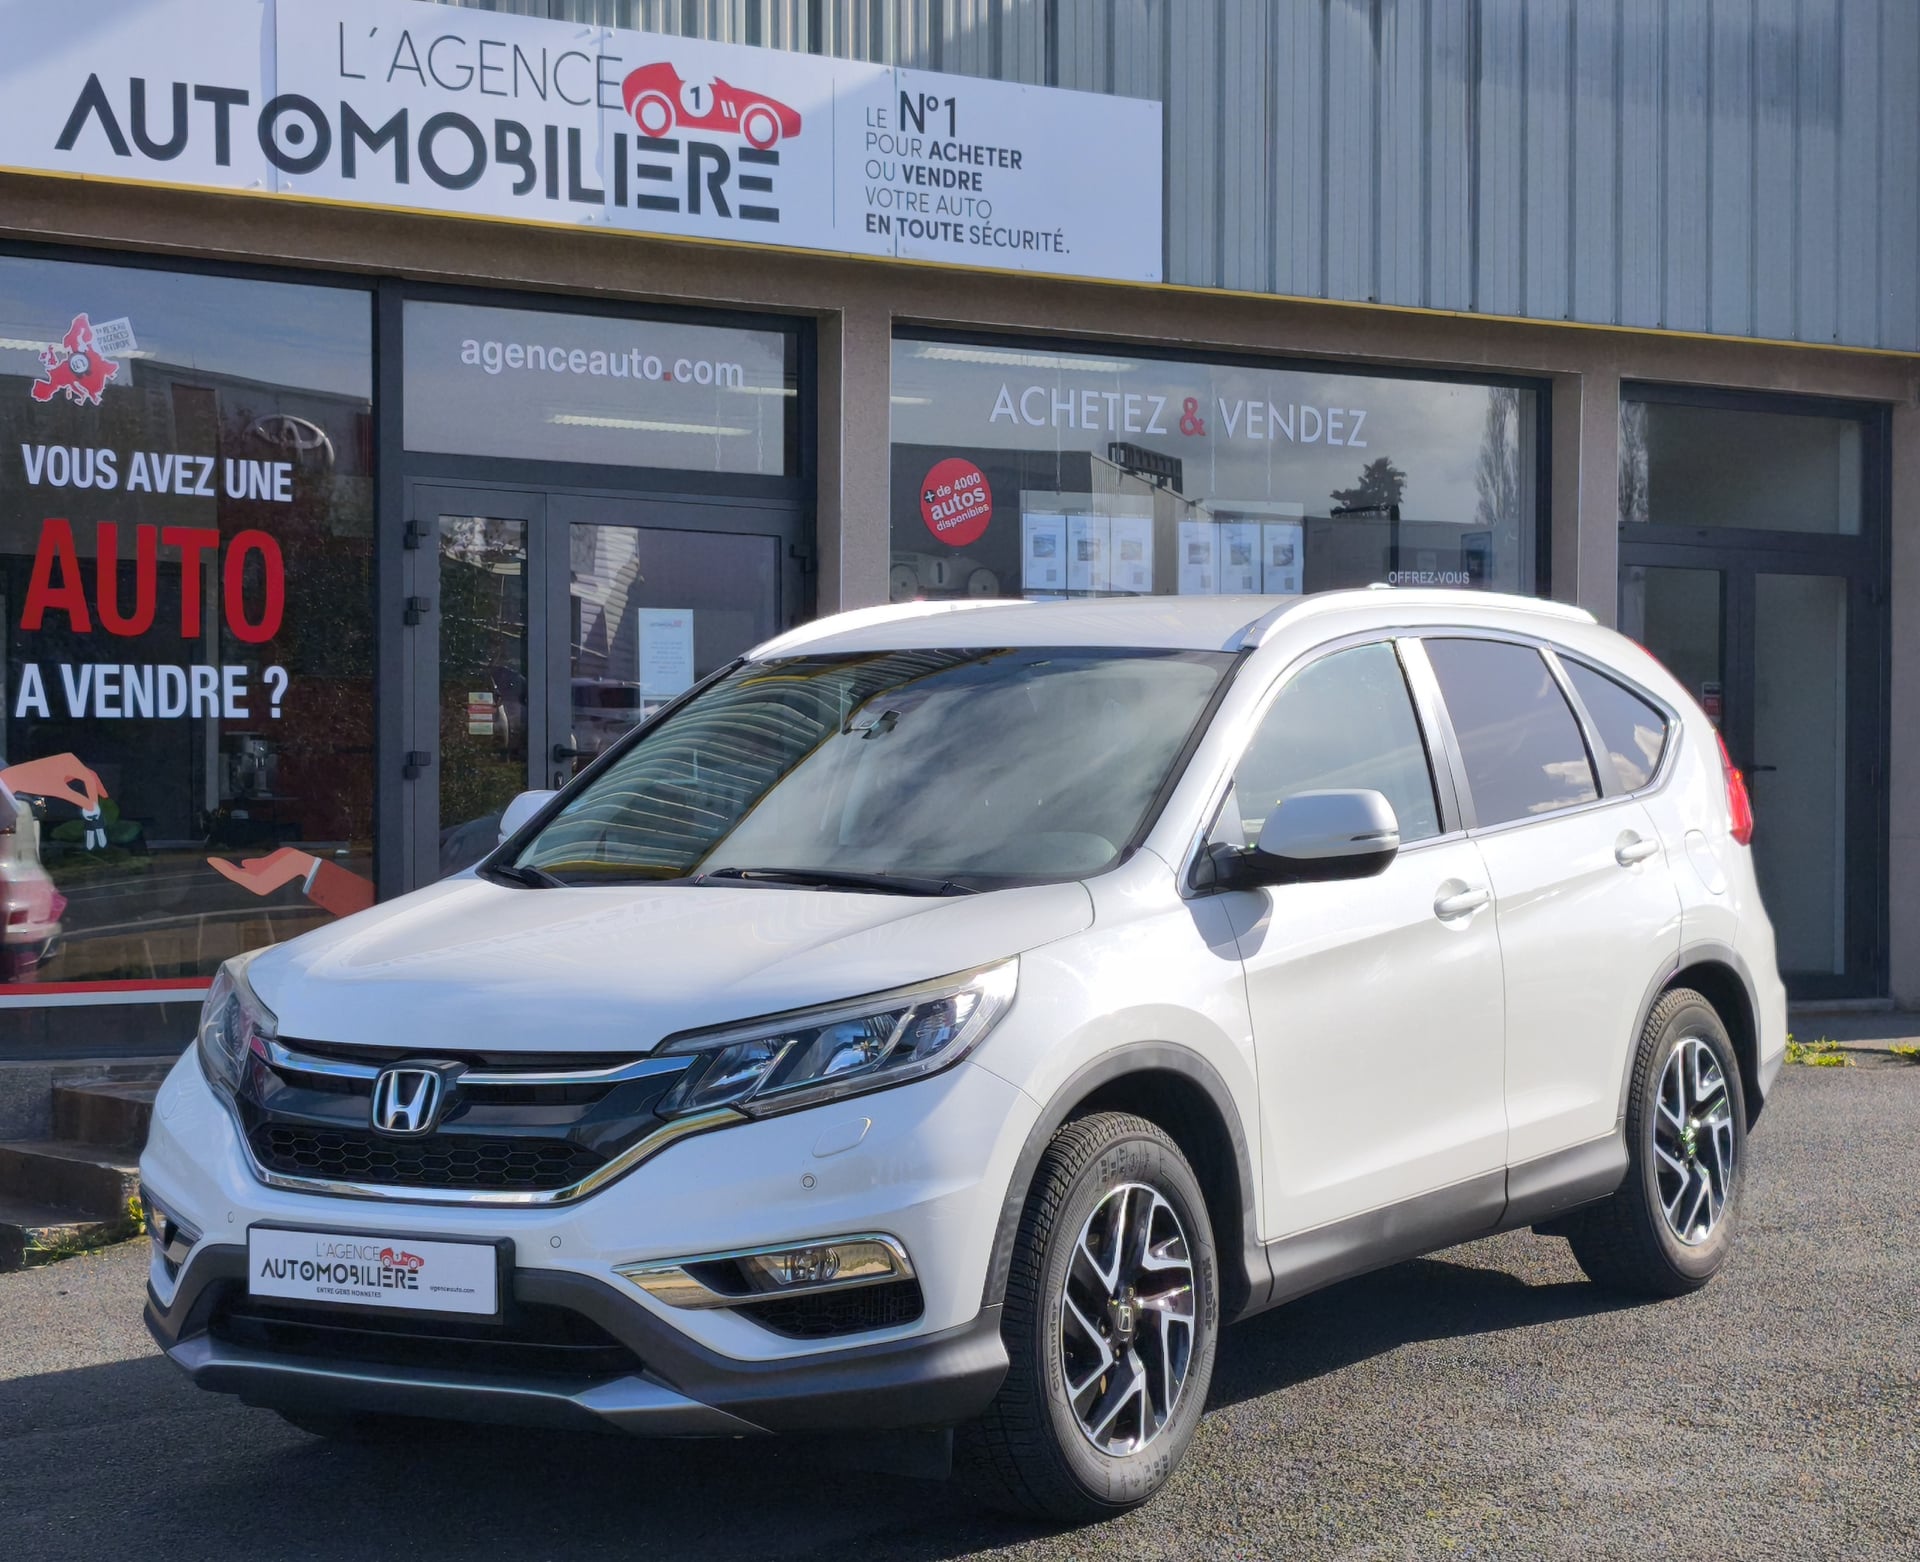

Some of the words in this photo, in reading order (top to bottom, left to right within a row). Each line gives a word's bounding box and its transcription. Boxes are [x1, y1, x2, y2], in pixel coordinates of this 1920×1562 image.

[339, 21, 623, 111] L'AGENCE
[690, 86, 701, 110] 1
[866, 106, 887, 129] LE
[54, 72, 780, 223] AUTOMOBILIERE
[865, 132, 922, 159] POUR
[928, 140, 1022, 170] ACHETER
[865, 160, 895, 182] OU
[902, 164, 982, 192] VENDRE
[865, 186, 929, 213] VOTRE
[936, 195, 992, 219] AUTO
[866, 213, 891, 235] EN
[896, 217, 964, 243] TOUTE
[969, 220, 1070, 254] SÉCURITÉ.
[461, 338, 744, 387] agenceauto.com
[989, 385, 1166, 434] ACHETEZ
[1179, 397, 1206, 436] &
[1217, 399, 1368, 447] VENDEZ
[21, 444, 119, 490] VOUS
[126, 452, 216, 497] AVEZ
[225, 458, 293, 502] UNE
[936, 485, 952, 499] de
[954, 472, 981, 491] 4000
[930, 487, 986, 521] autos
[936, 503, 990, 532] disponibles
[19, 517, 286, 645] AUTO
[1388, 571, 1470, 584] OFFREZ-VOUS
[15, 663, 50, 719] A
[60, 663, 250, 719] VENDRE
[263, 665, 289, 719] ?
[316, 1241, 381, 1262] L'AGENCE
[260, 1257, 419, 1290] AUTOMOBILIERE
